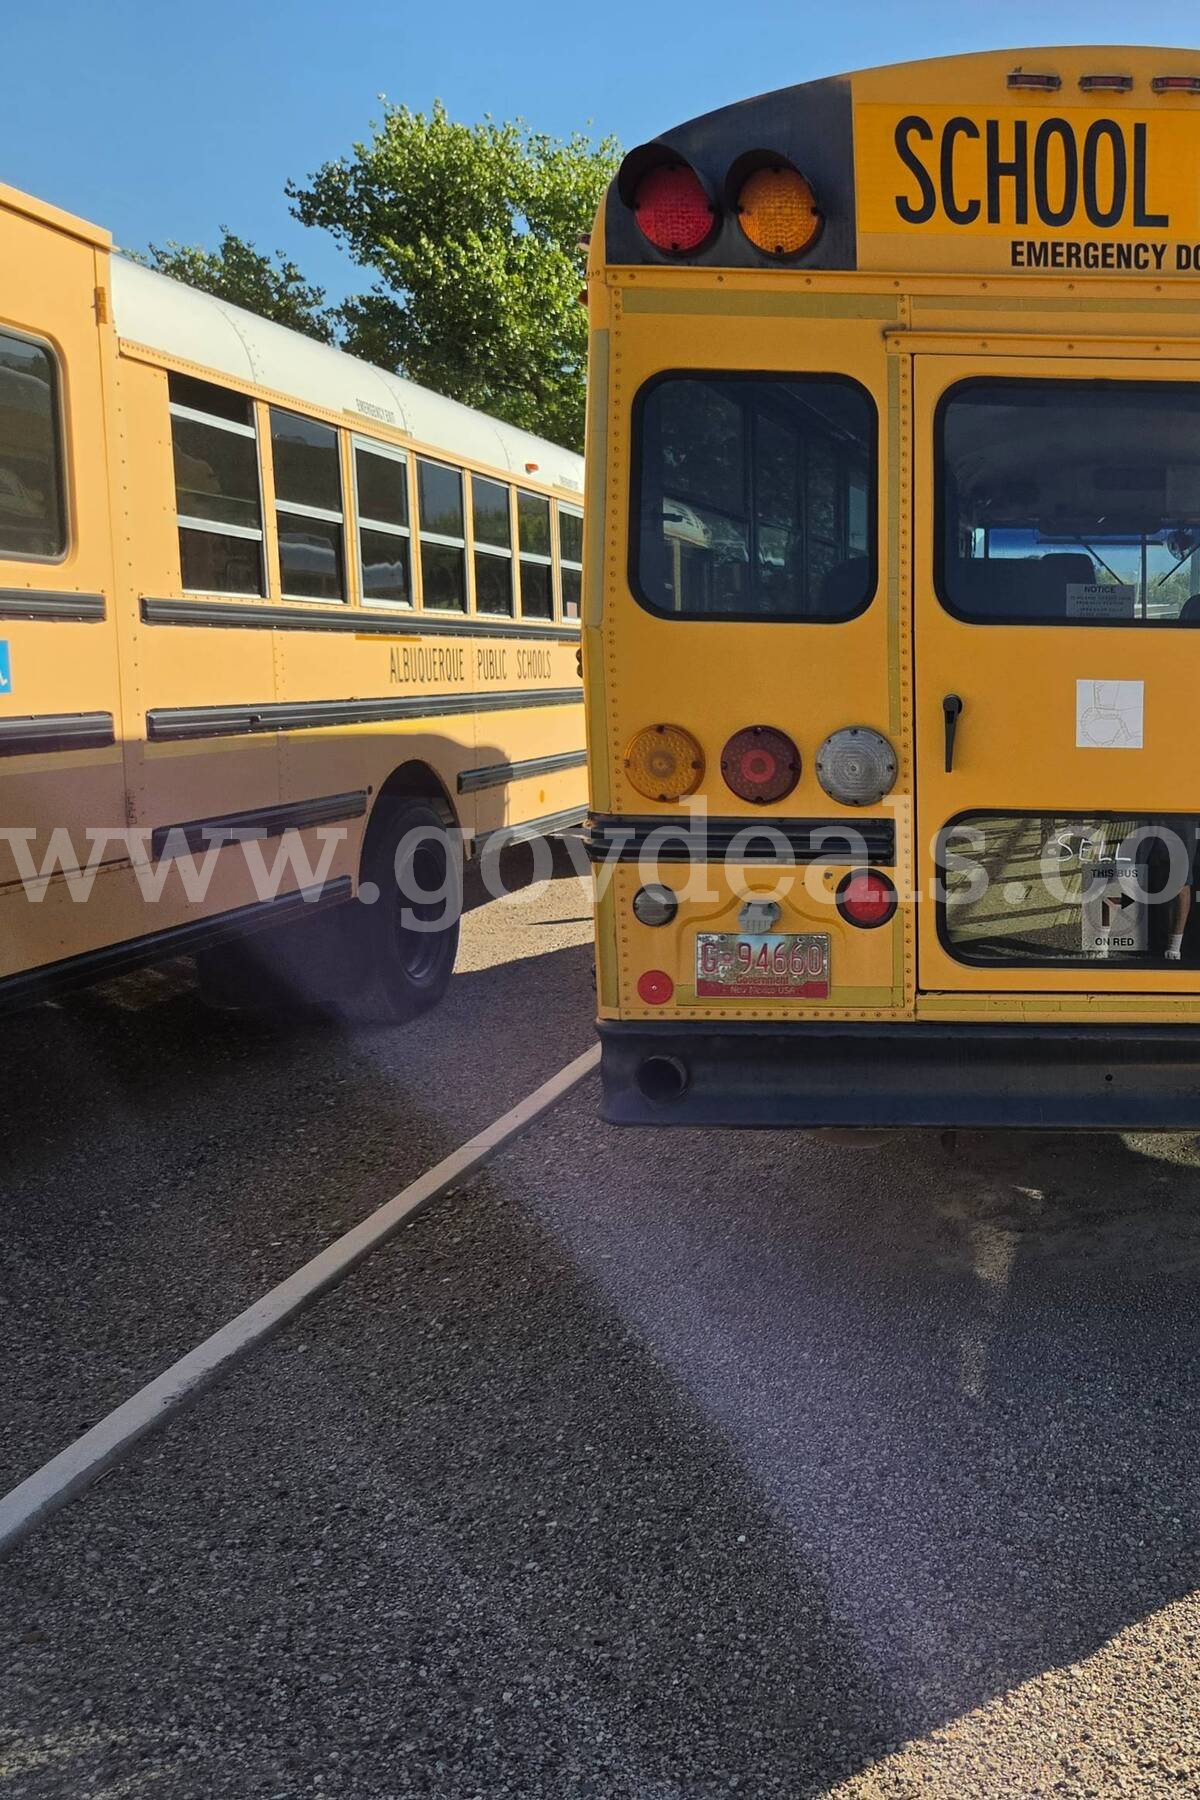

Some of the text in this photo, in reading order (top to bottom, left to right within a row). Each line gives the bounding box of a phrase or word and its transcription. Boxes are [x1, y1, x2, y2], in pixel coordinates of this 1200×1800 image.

[894, 115, 1169, 228] SCHOOL
[1010, 240, 1167, 271] EMERGENCY
[1084, 586, 1116, 594] NOTICE
[390, 648, 551, 683] ALBUQUERQUE PUBLIC SCHOOLS
[1056, 833, 1131, 862] SELL
[1091, 869, 1138, 878] THIS BUS
[1095, 938, 1134, 946] ON RED
[778, 986, 796, 994] USA
